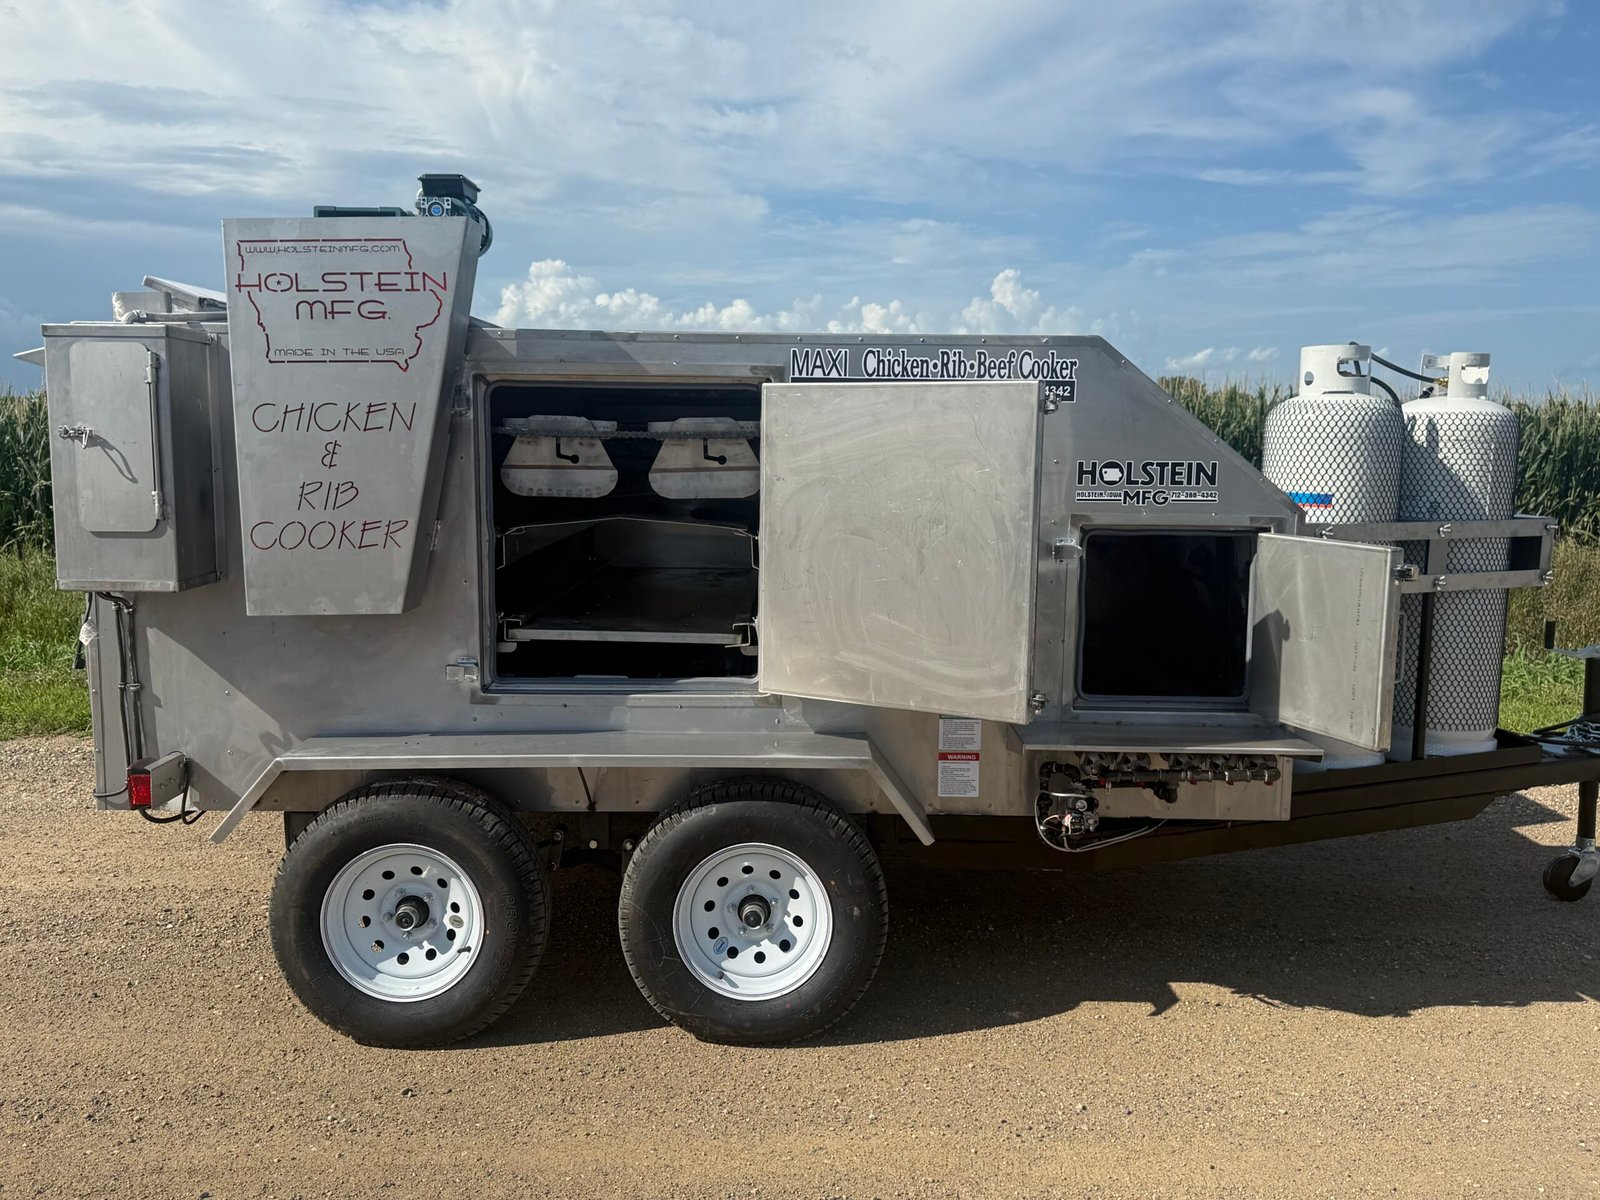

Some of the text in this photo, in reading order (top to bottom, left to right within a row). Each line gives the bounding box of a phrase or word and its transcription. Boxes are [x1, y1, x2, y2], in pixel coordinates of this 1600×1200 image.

[235, 272, 448, 293] HOLSTEIN
[274, 348, 405, 356] MADE IN THE USA
[790, 348, 849, 377] MAXI
[1019, 350, 1078, 380] Cooker
[252, 402, 416, 433] CHICKEN
[321, 440, 342, 469] &
[1076, 461, 1218, 486] HOLSTEIN
[298, 481, 359, 511] RIB
[1122, 490, 1169, 505] MFG
[250, 520, 409, 550] COOKER
